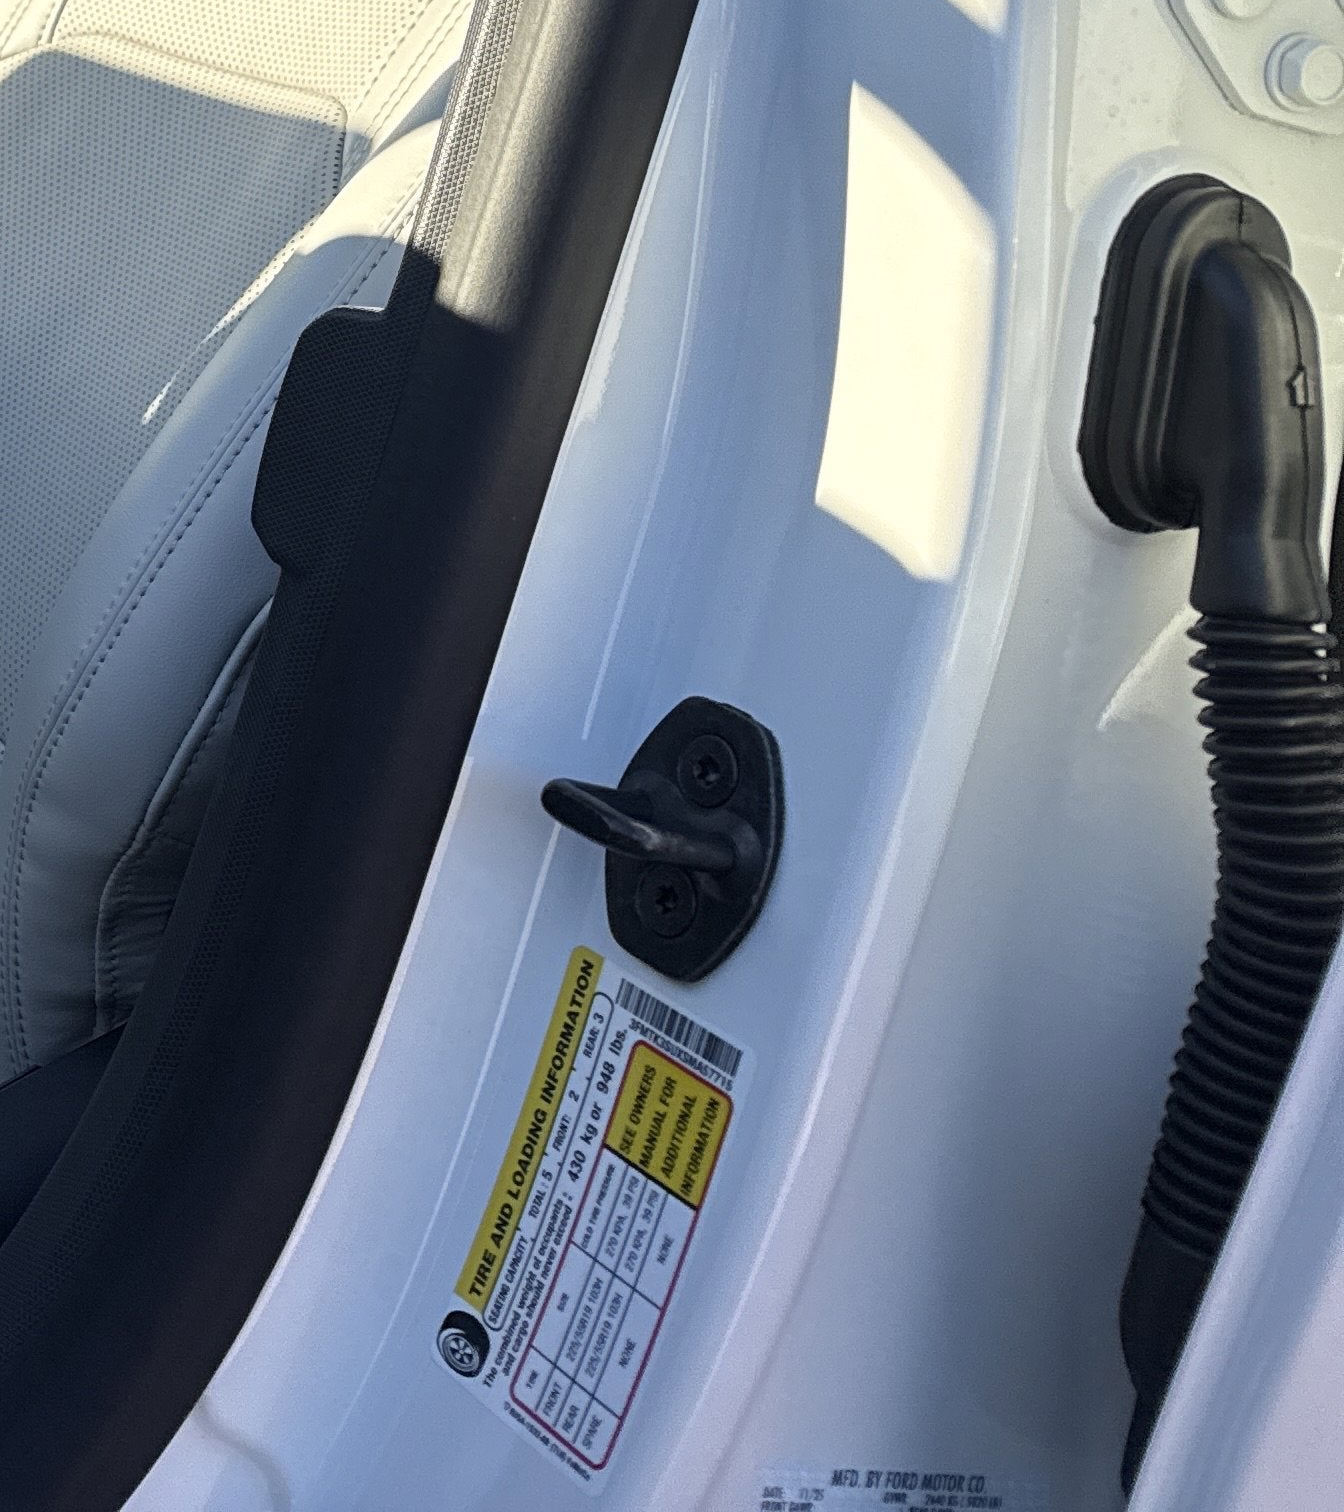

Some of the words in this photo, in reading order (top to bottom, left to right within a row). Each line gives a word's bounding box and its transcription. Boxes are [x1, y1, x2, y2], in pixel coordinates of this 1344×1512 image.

[595, 1060, 616, 1094] 948
[608, 1024, 628, 1055] lbs.
[469, 1248, 495, 1300] TIRE
[489, 1200, 513, 1248] AND
[507, 1106, 547, 1200] LOADING
[539, 958, 594, 1104] INFORMATION
[579, 1121, 598, 1145] kg
[589, 1101, 603, 1121] or
[618, 1125, 636, 1154] SEE
[627, 1063, 656, 1125] OWNERS
[637, 1107, 666, 1168] MANUAL
[658, 1075, 677, 1106] FOR
[659, 1091, 697, 1178] ADDITIONAL
[678, 1097, 721, 1196] INFORMATION
[488, 1282, 510, 1325] SEATING
[504, 1235, 527, 1283] CAPACITY
[528, 1187, 545, 1219] TOTAL
[541, 1168, 553, 1181] 5
[568, 1089, 579, 1101] 2
[593, 1011, 604, 1023] 3
[566, 1148, 586, 1183] 430
[483, 1364, 497, 1387] The
[495, 1311, 520, 1367] combined
[516, 1270, 536, 1311] weight
[531, 1256, 541, 1270] of
[537, 1197, 563, 1256] occupants
[501, 1352, 515, 1377] and
[512, 1318, 530, 1354] cargo
[524, 1279, 544, 1319] should
[540, 1246, 557, 1280] never
[552, 1204, 572, 1246] exceed
[581, 1414, 601, 1451] SPARE
[618, 1337, 636, 1369] NONE
[656, 1234, 673, 1265] NONE
[543, 1381, 562, 1418] FRONT
[562, 1403, 579, 1434] REAR
[885, 1471, 918, 1490] FORD
[921, 1474, 965, 1492] MOTOR
